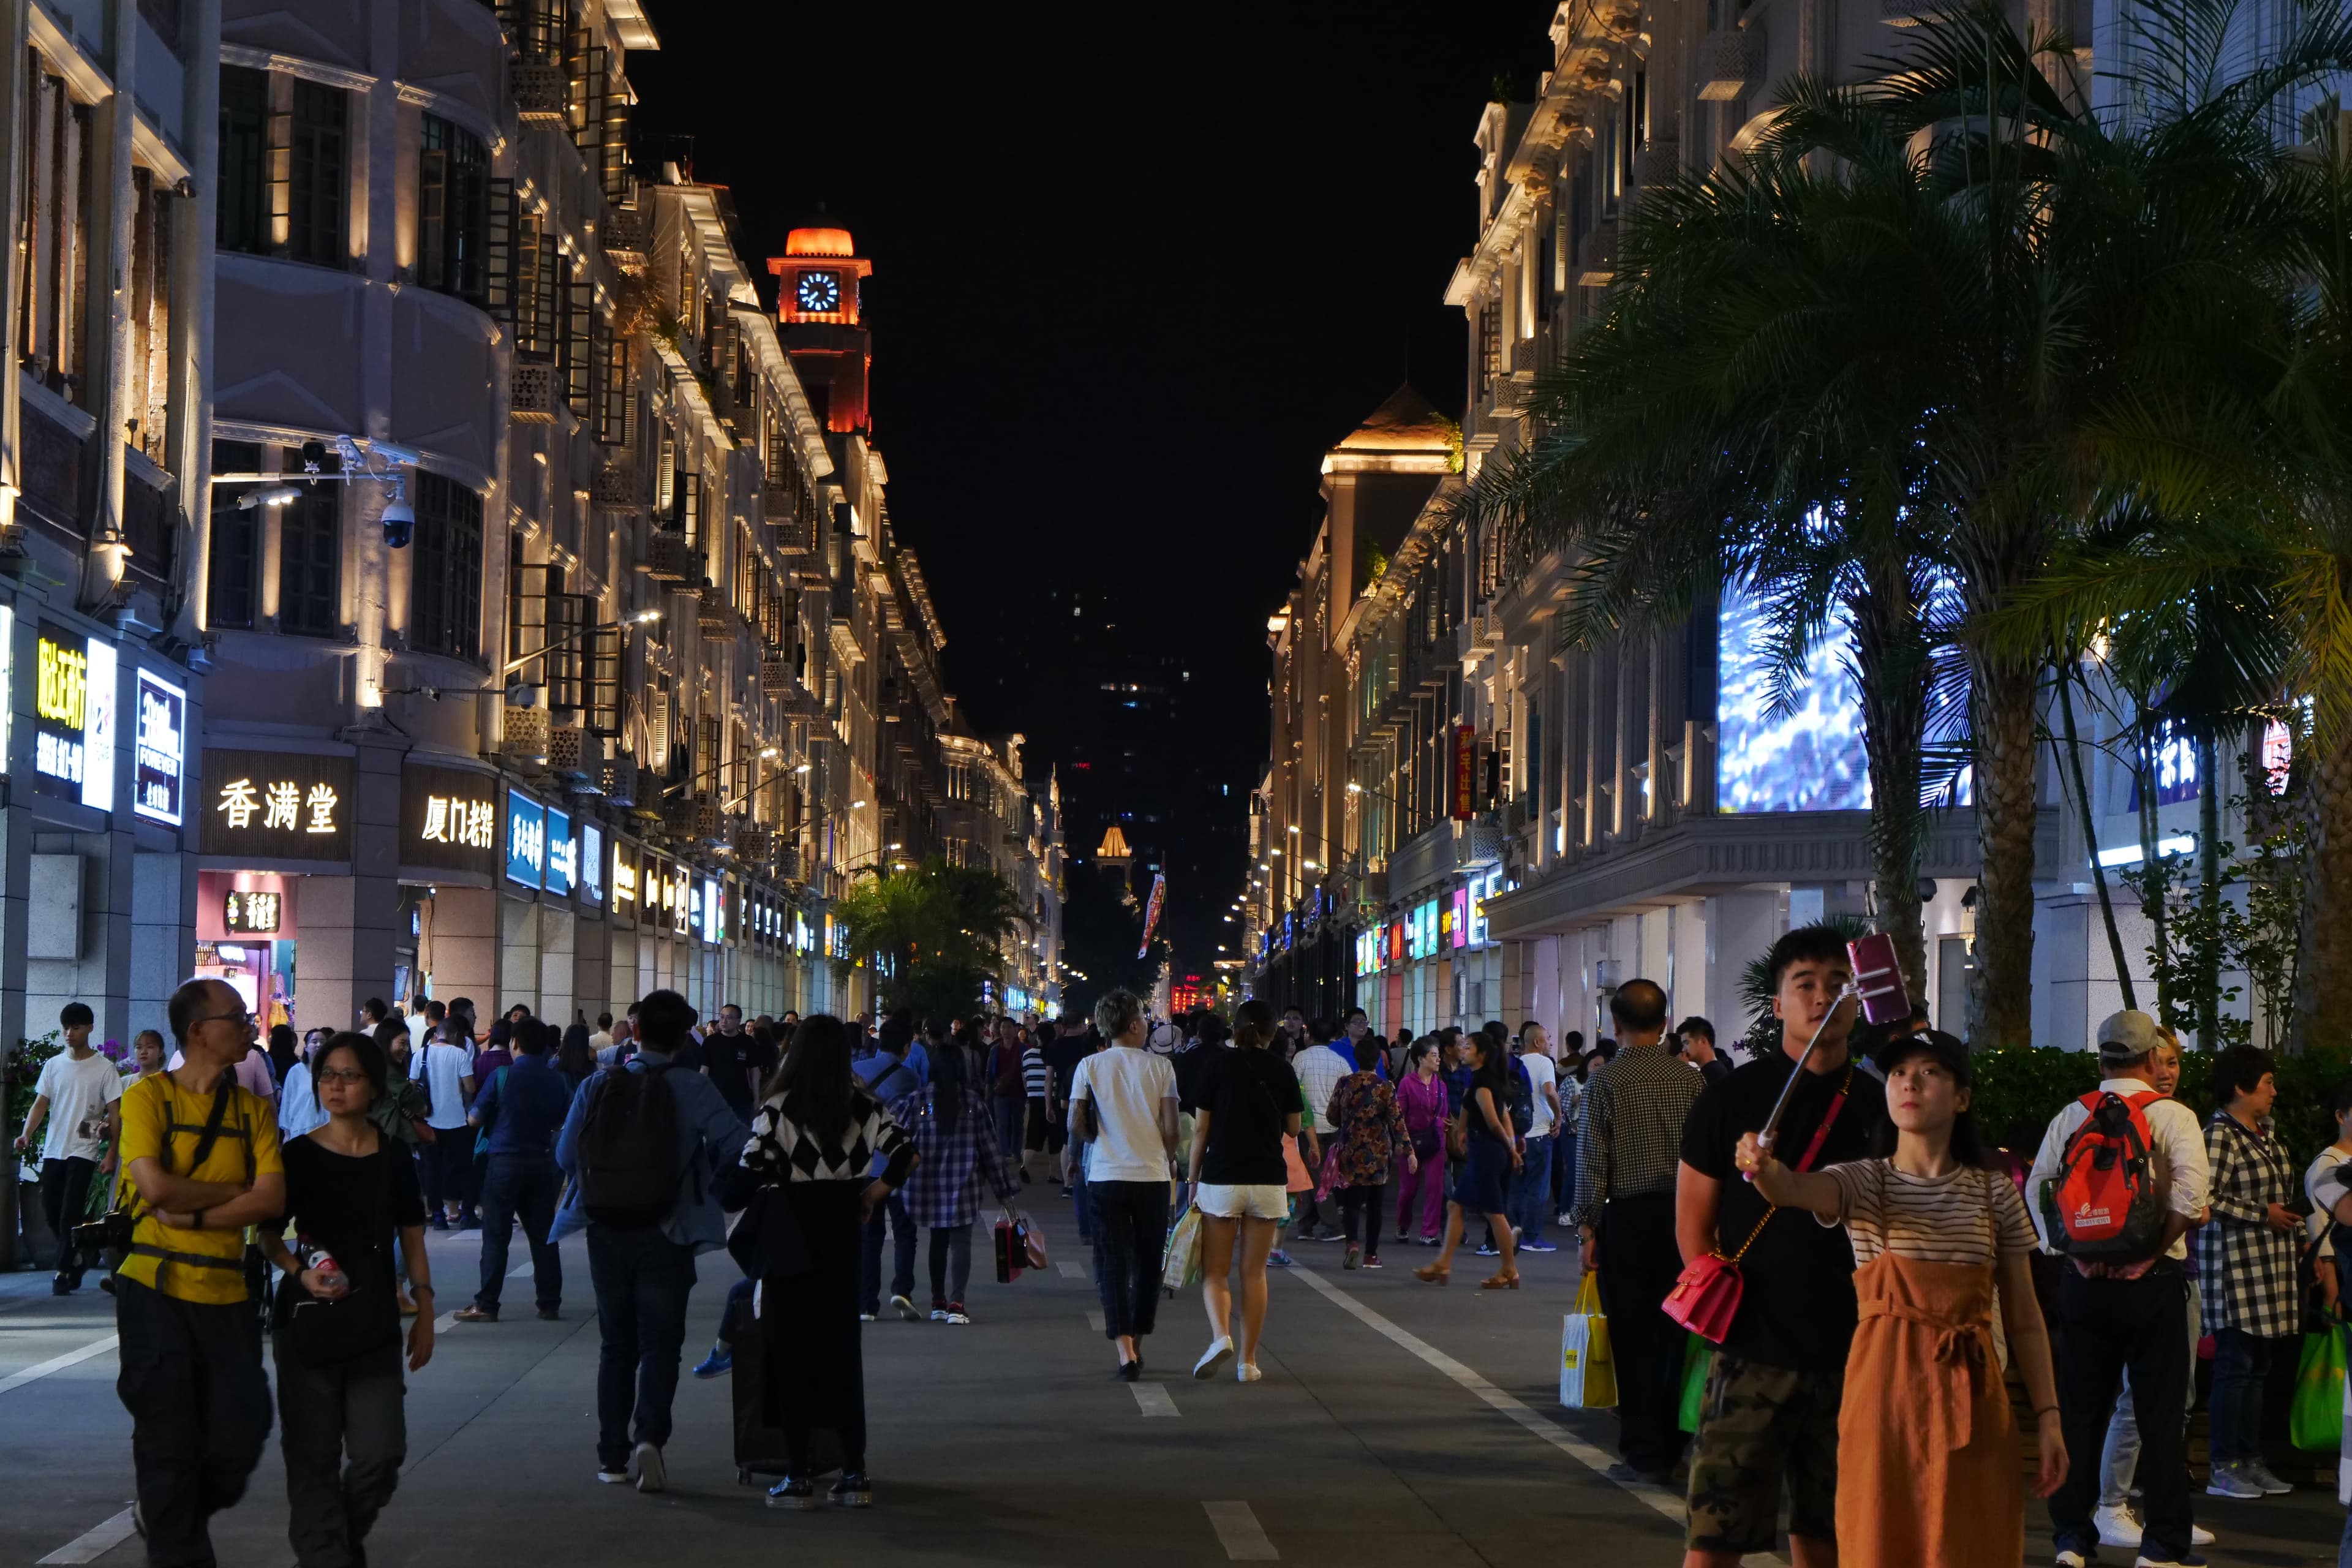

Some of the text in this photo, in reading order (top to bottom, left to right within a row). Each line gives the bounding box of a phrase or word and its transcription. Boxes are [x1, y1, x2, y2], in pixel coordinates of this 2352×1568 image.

[140, 746, 177, 777] FOREVER
[217, 778, 337, 833] 香满堂
[422, 795, 494, 849] 厦门老字号
